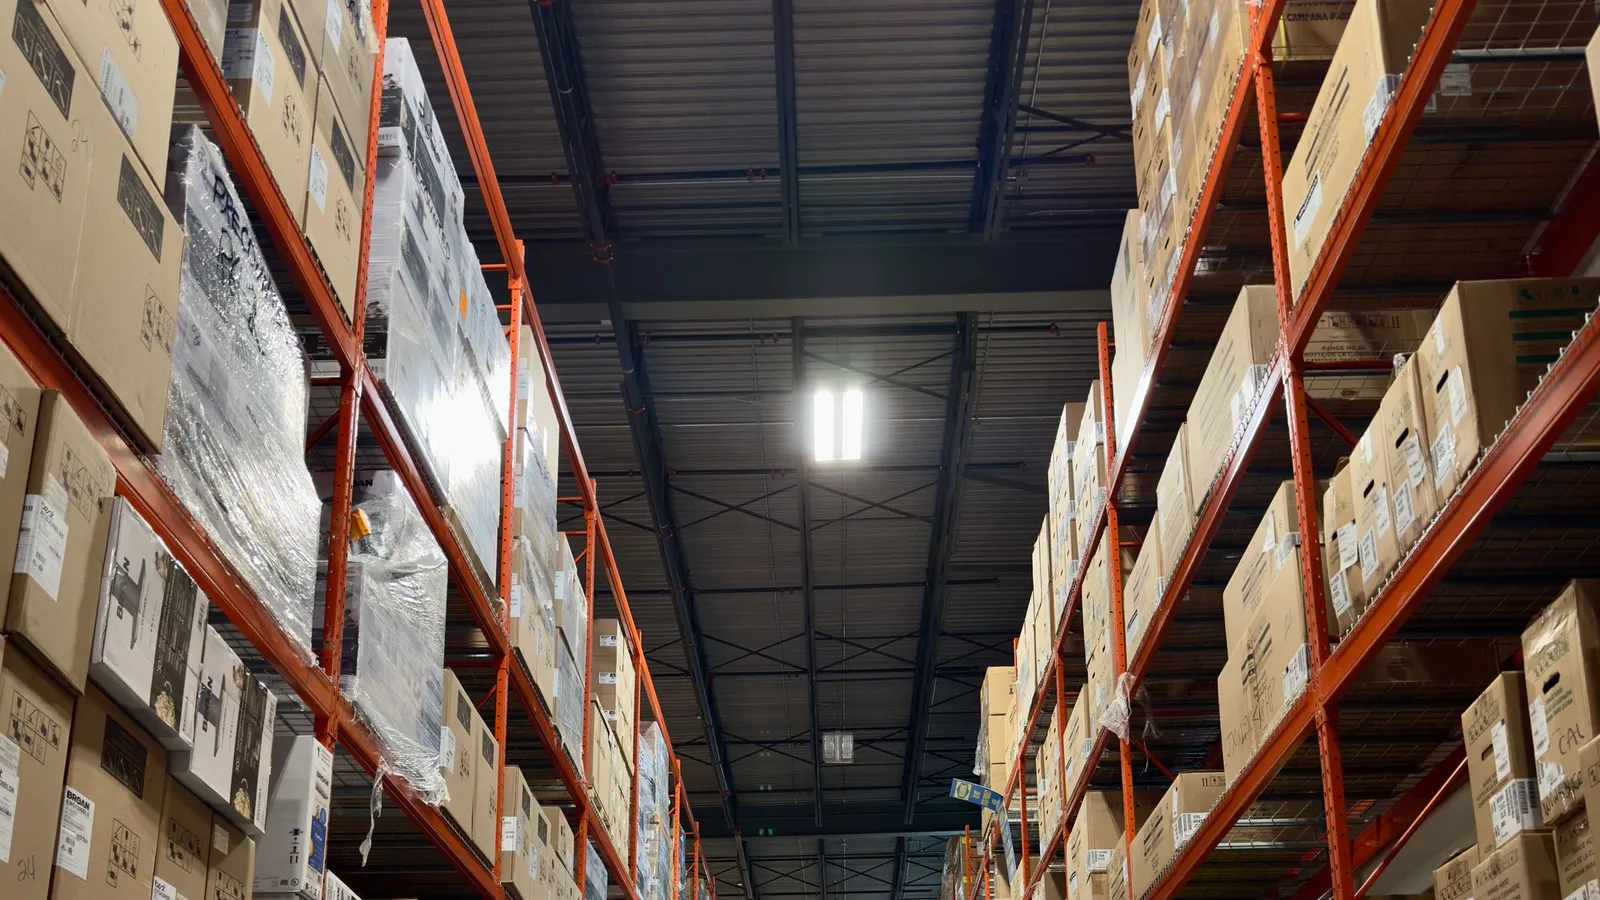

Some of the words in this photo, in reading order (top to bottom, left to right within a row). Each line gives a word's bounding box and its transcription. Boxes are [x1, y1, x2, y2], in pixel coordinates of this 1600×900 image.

[1559, 723, 1585, 755] CAL
[66, 790, 90, 811] BROAN
[17, 854, 36, 882] 24
